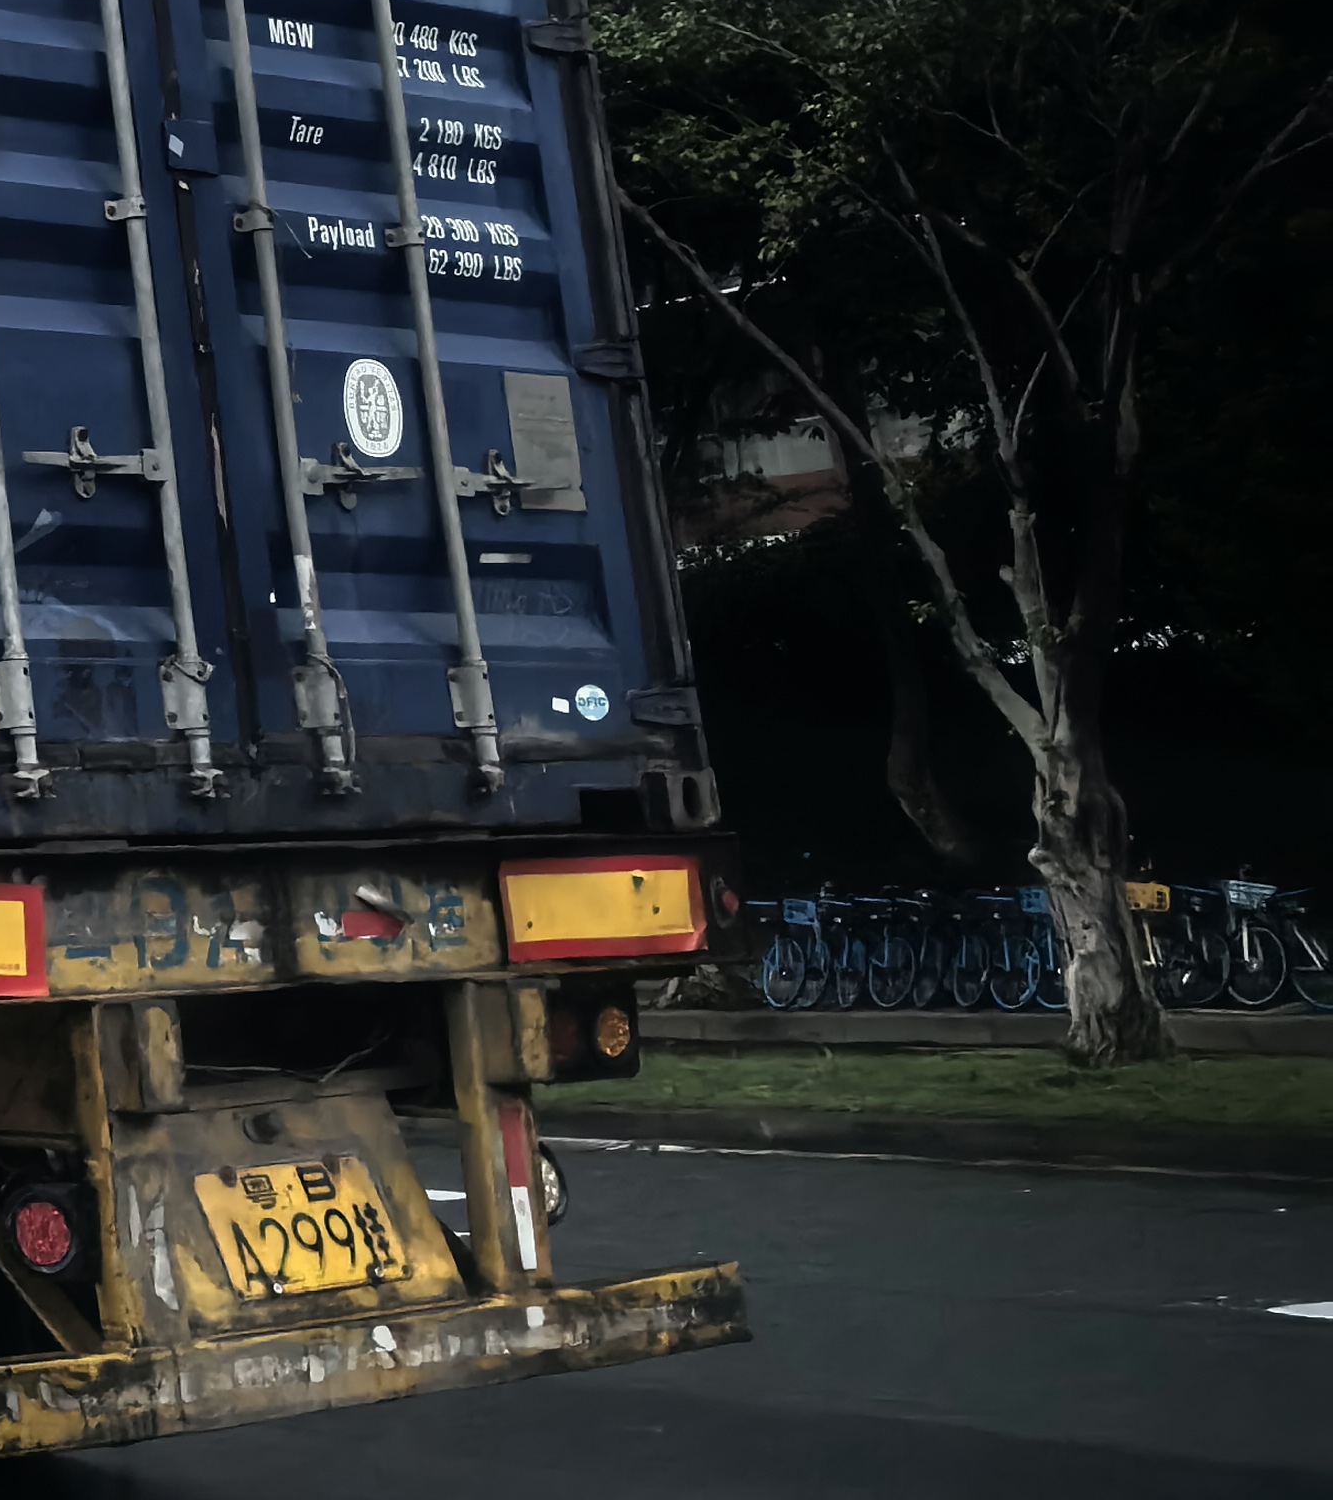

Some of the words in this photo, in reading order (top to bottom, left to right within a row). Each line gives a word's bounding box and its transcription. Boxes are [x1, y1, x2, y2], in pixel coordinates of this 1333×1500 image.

[268, 18, 314, 49] MGW
[410, 24, 438, 51] 480
[449, 30, 478, 56] KGS
[413, 58, 447, 83] 200
[452, 63, 486, 88] LBS
[289, 116, 324, 145] Tare
[474, 123, 502, 150] KGS
[467, 158, 497, 185] LBS
[307, 217, 375, 250] Payload
[485, 222, 519, 247] KGS
[493, 255, 522, 281] LBS
